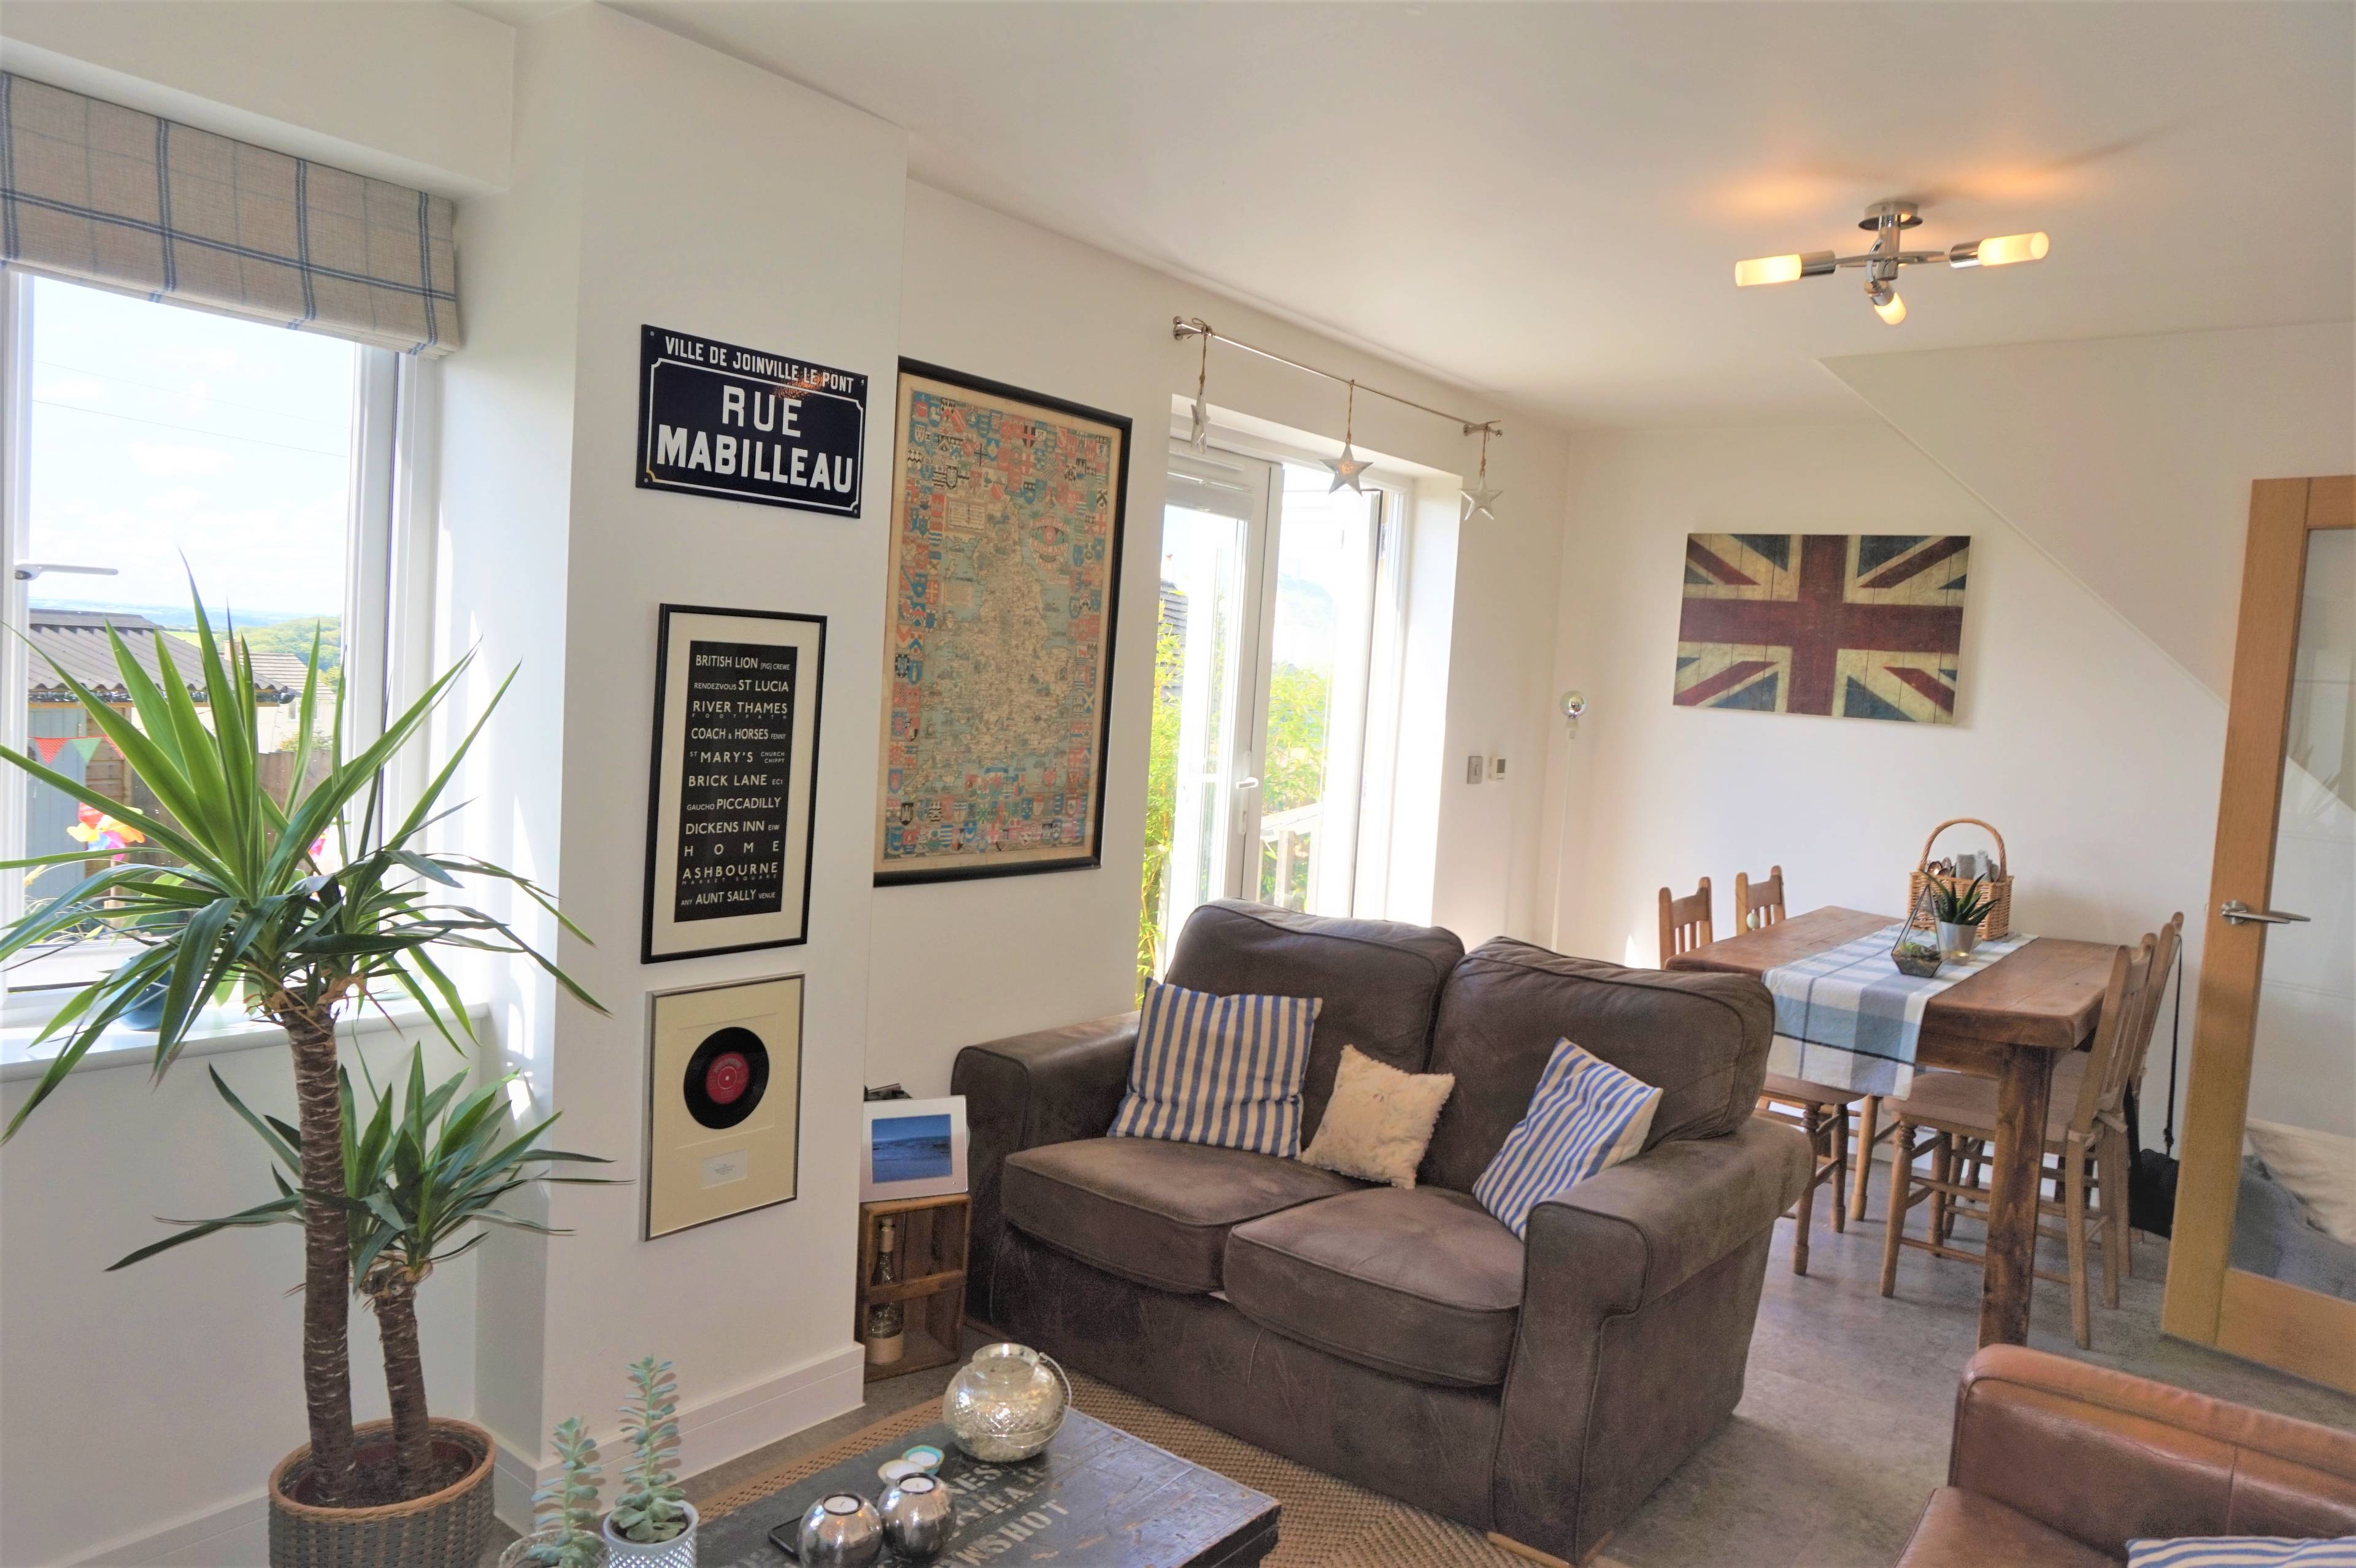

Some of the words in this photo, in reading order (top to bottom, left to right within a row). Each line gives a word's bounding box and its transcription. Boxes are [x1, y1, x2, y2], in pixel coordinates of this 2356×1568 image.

[665, 336, 704, 361] VILLE
[710, 346, 727, 366] DE
[733, 352, 799, 381] JOINVILLE
[803, 367, 817, 386] LE
[822, 372, 853, 393] PONT
[722, 385, 802, 437] RUE
[656, 424, 853, 493] MABILLEAU
[696, 655, 732, 667] BRITISH
[735, 657, 758, 669] LION
[738, 680, 752, 690] ST
[755, 680, 789, 692] LUCIA
[693, 701, 731, 712] RIVER
[737, 702, 788, 713] THAMES
[691, 728, 726, 739] COACH
[734, 729, 768, 740] HORSES
[700, 751, 753, 763] MARY'S
[688, 775, 728, 786] BRICK
[734, 775, 768, 786] LANE
[717, 797, 781, 809] PICCADILLY
[686, 821, 739, 834] DICKENS
[743, 821, 764, 831] INN
[685, 840, 779, 856] HOME
[682, 862, 778, 879] ASHBOURNE
[695, 892, 725, 904] AUNT
[727, 890, 756, 902] SALLY
